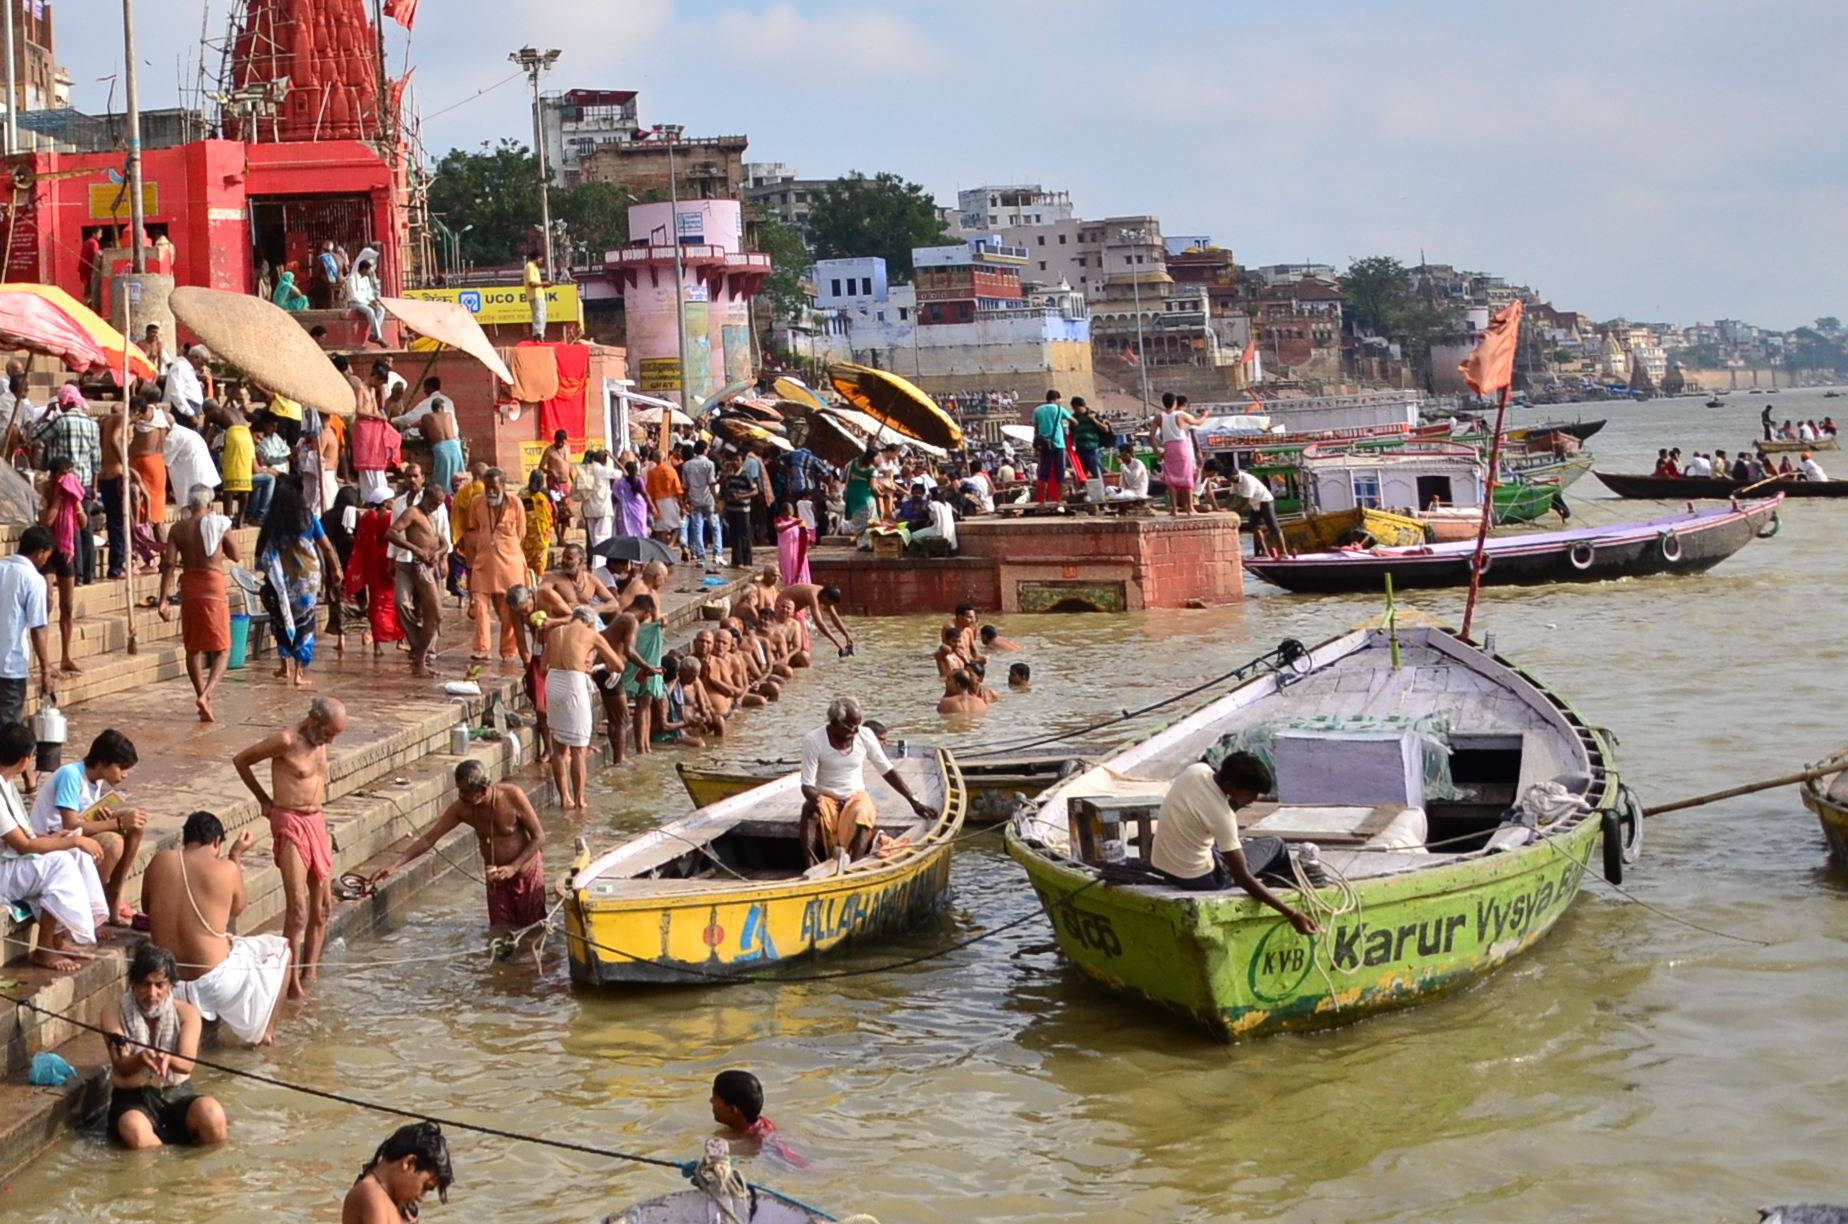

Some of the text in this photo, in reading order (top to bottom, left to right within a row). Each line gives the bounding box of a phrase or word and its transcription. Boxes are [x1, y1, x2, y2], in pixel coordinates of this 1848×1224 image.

[485, 291, 558, 304] UCO BK
[1330, 879, 1553, 971] Karur Vysya
[1262, 948, 1304, 976] KVB
